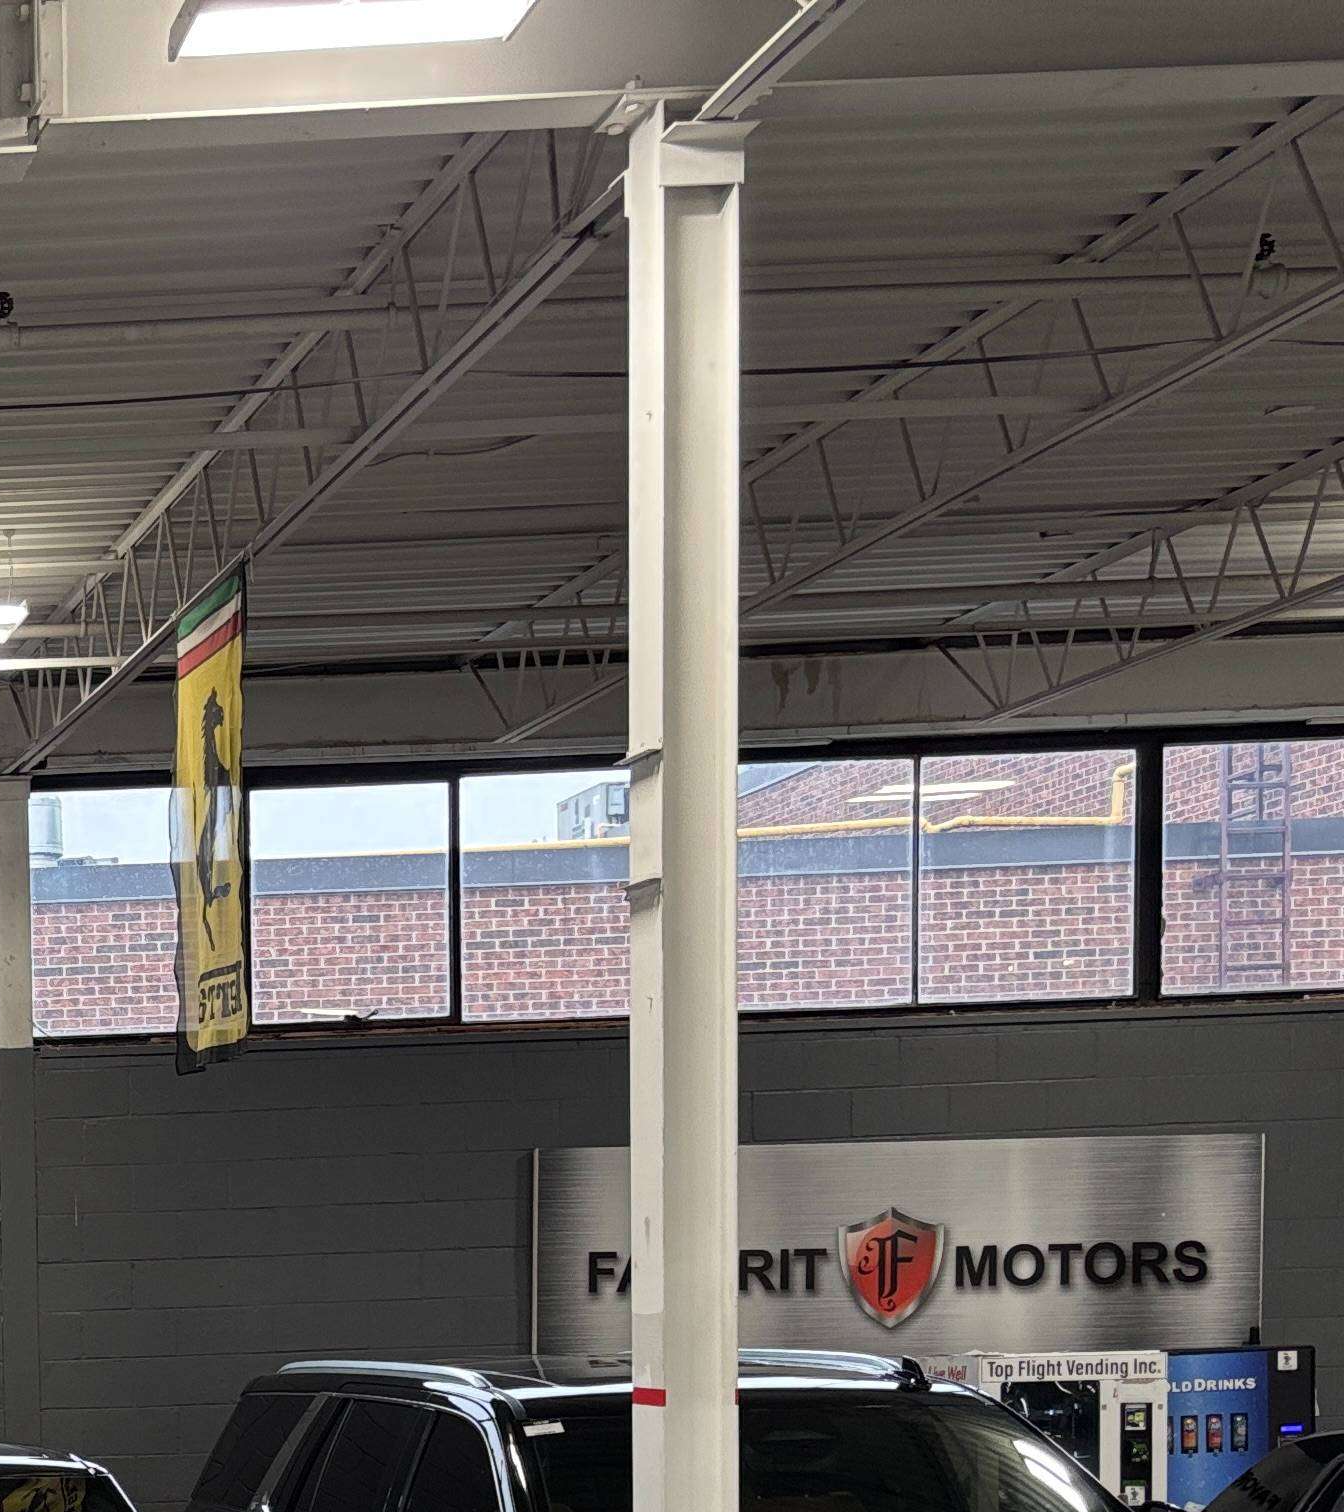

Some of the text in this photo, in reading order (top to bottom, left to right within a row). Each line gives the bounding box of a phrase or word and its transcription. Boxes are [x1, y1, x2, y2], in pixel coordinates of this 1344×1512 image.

[589, 1248, 827, 1293] FRIT
[955, 1240, 1209, 1287] MOTORS
[987, 1358, 1162, 1380] Top Flight Vending Inc.
[1194, 1377, 1257, 1392] DRINKS
